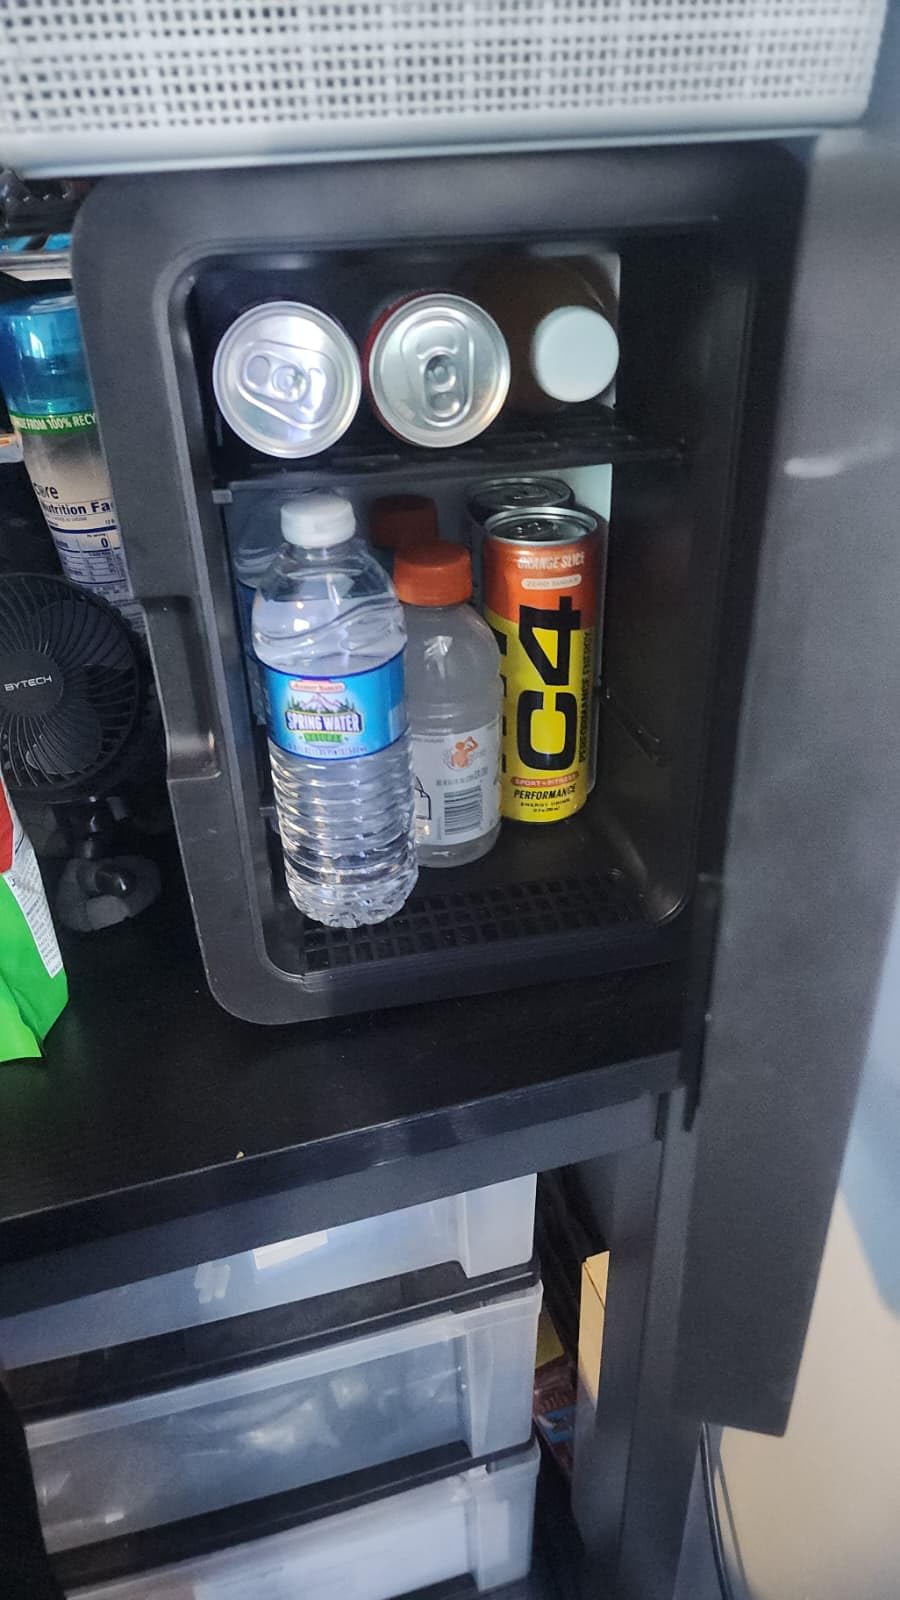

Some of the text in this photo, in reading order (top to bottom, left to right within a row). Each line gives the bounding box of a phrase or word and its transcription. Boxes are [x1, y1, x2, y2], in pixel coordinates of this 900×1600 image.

[47, 415, 72, 430] 100%
[90, 501, 114, 514] Fa
[101, 537, 109, 549] 0
[518, 552, 584, 570] ORANGE SLICE
[4, 675, 52, 692] BYTECH
[517, 596, 581, 771] C4
[288, 711, 360, 732] SPRING WATER
[513, 783, 577, 800] PERFORMANCE
